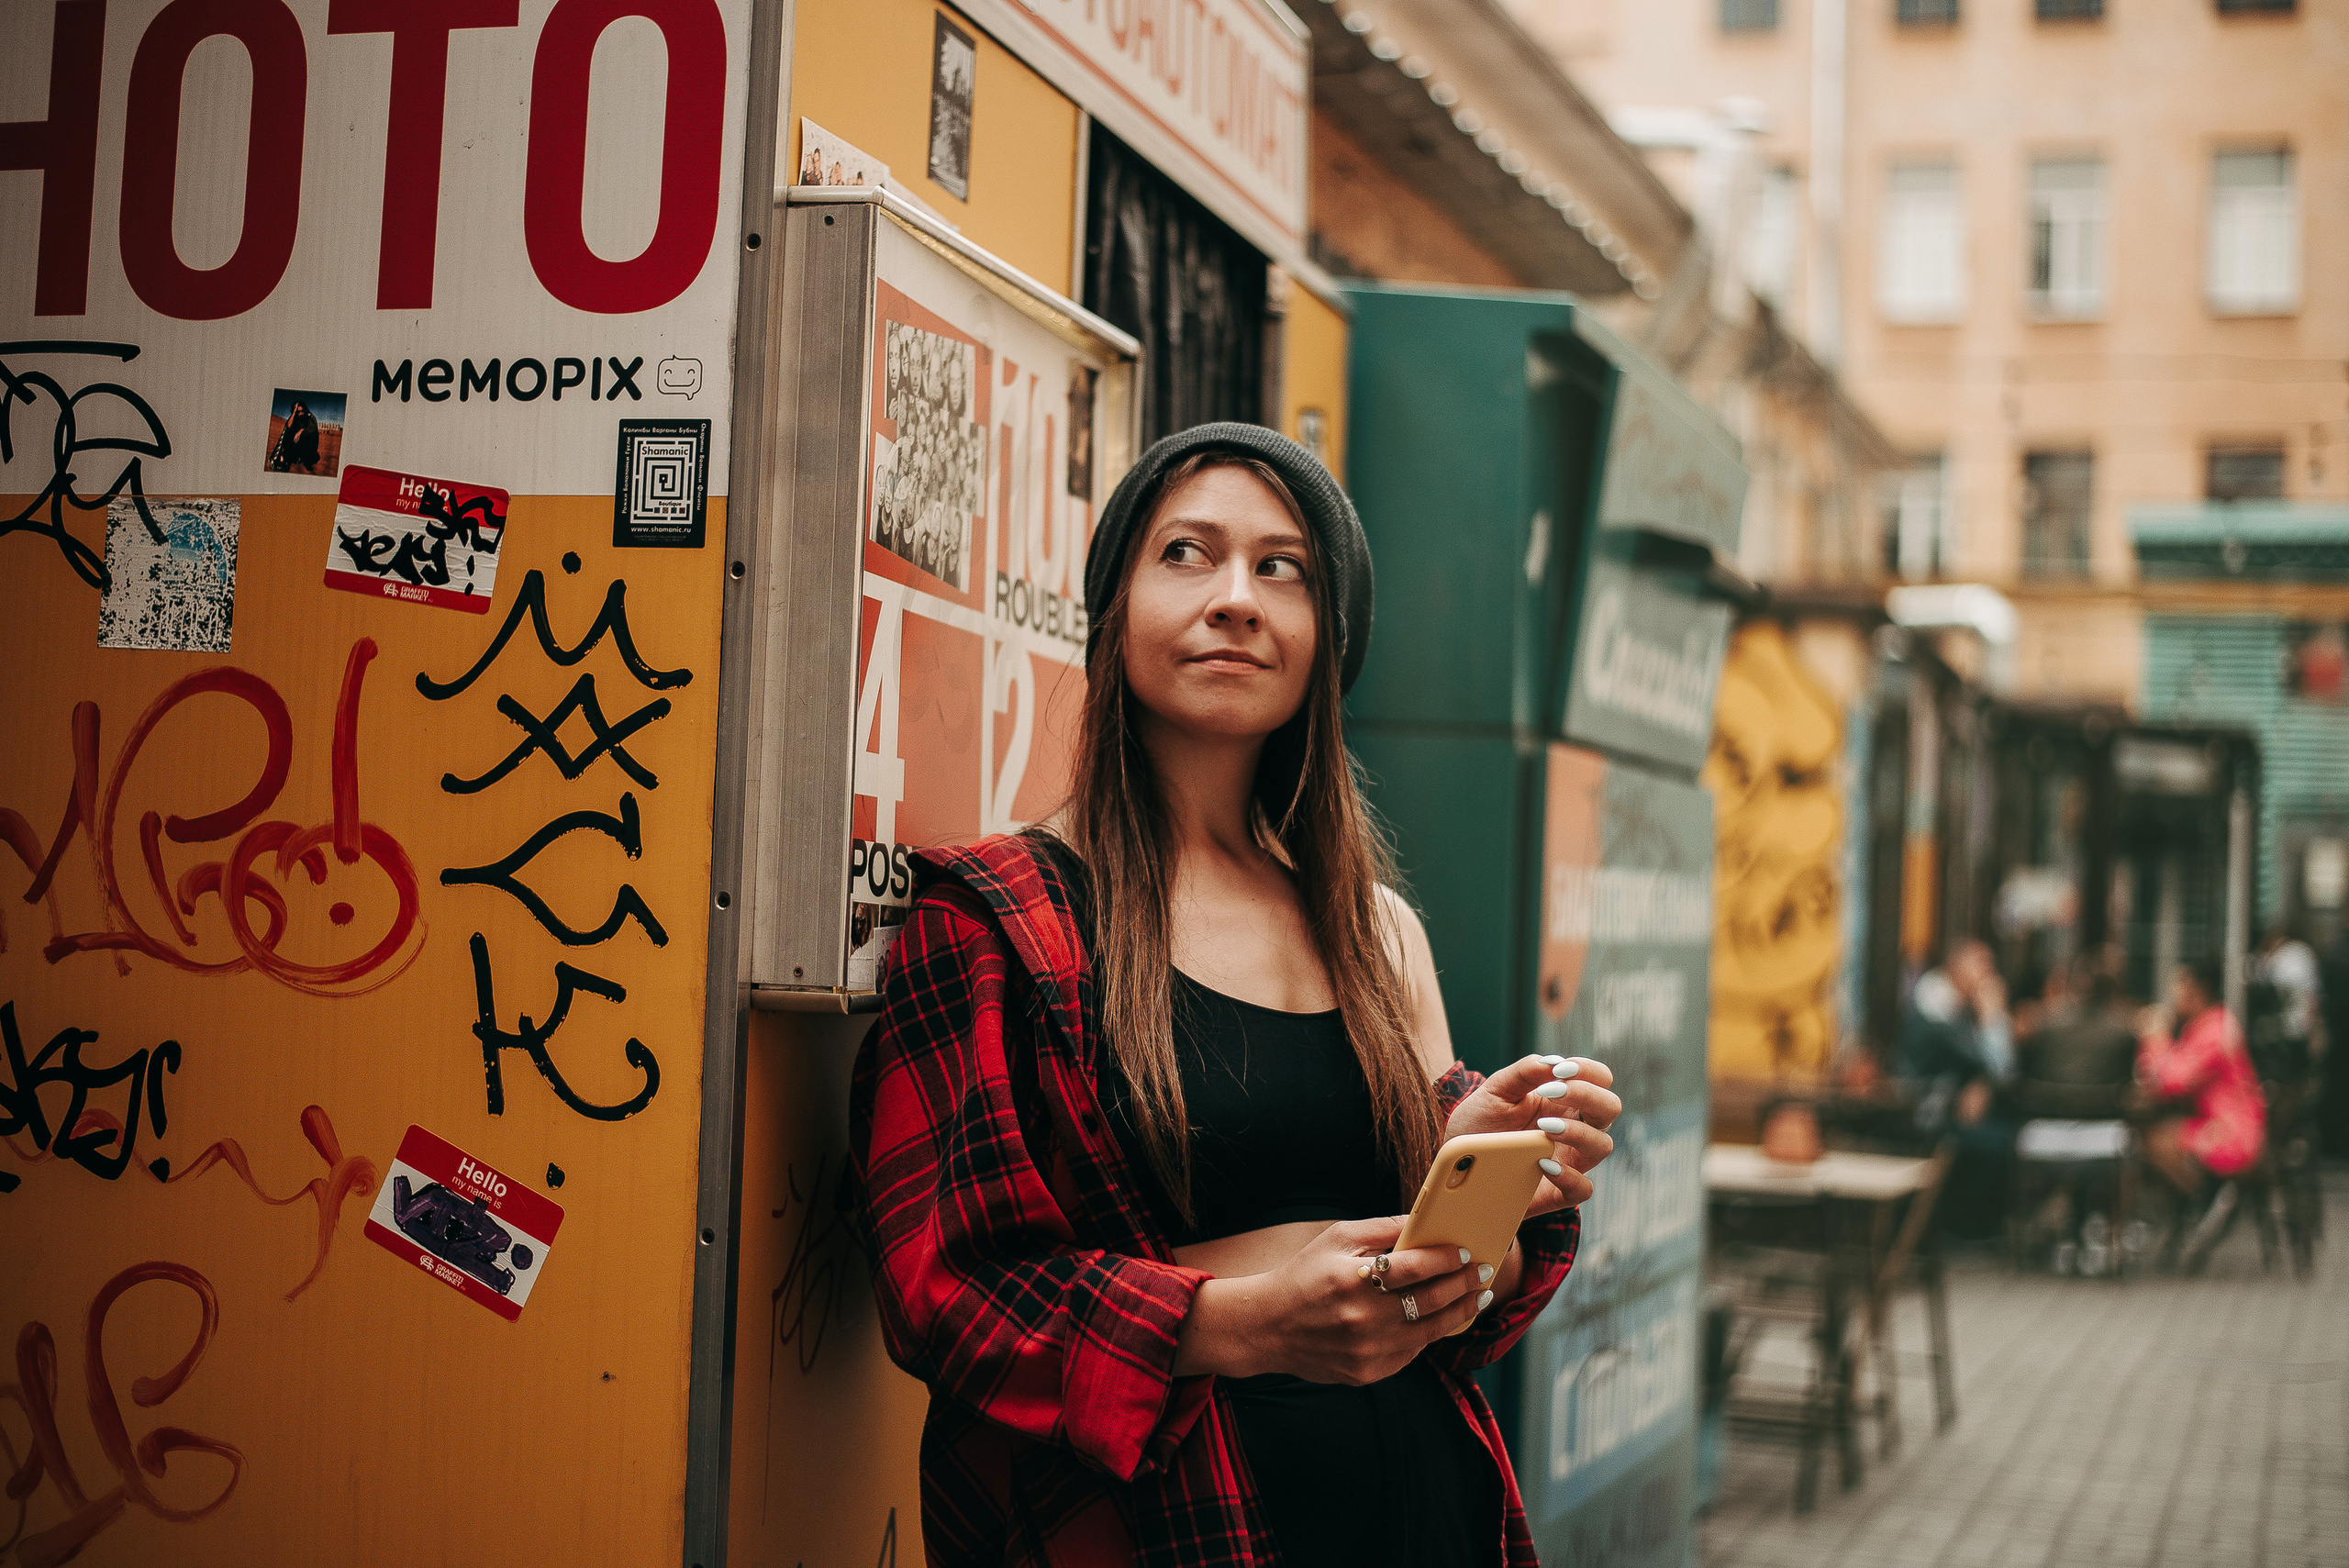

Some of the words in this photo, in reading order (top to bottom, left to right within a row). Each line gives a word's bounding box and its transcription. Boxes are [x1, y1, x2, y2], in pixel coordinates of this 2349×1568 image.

[641, 446, 689, 456] Shamanic
[395, 498, 410, 510] my
[400, 591, 428, 602] MARKET
[854, 587, 905, 844] 4
[851, 839, 925, 899] POS
[457, 1157, 507, 1197] Hello
[451, 1175, 466, 1190] my
[466, 1184, 493, 1203] name
[493, 1197, 502, 1209] is
[434, 1268, 462, 1287] MARKET
[437, 1263, 464, 1284] GRAFFITI
